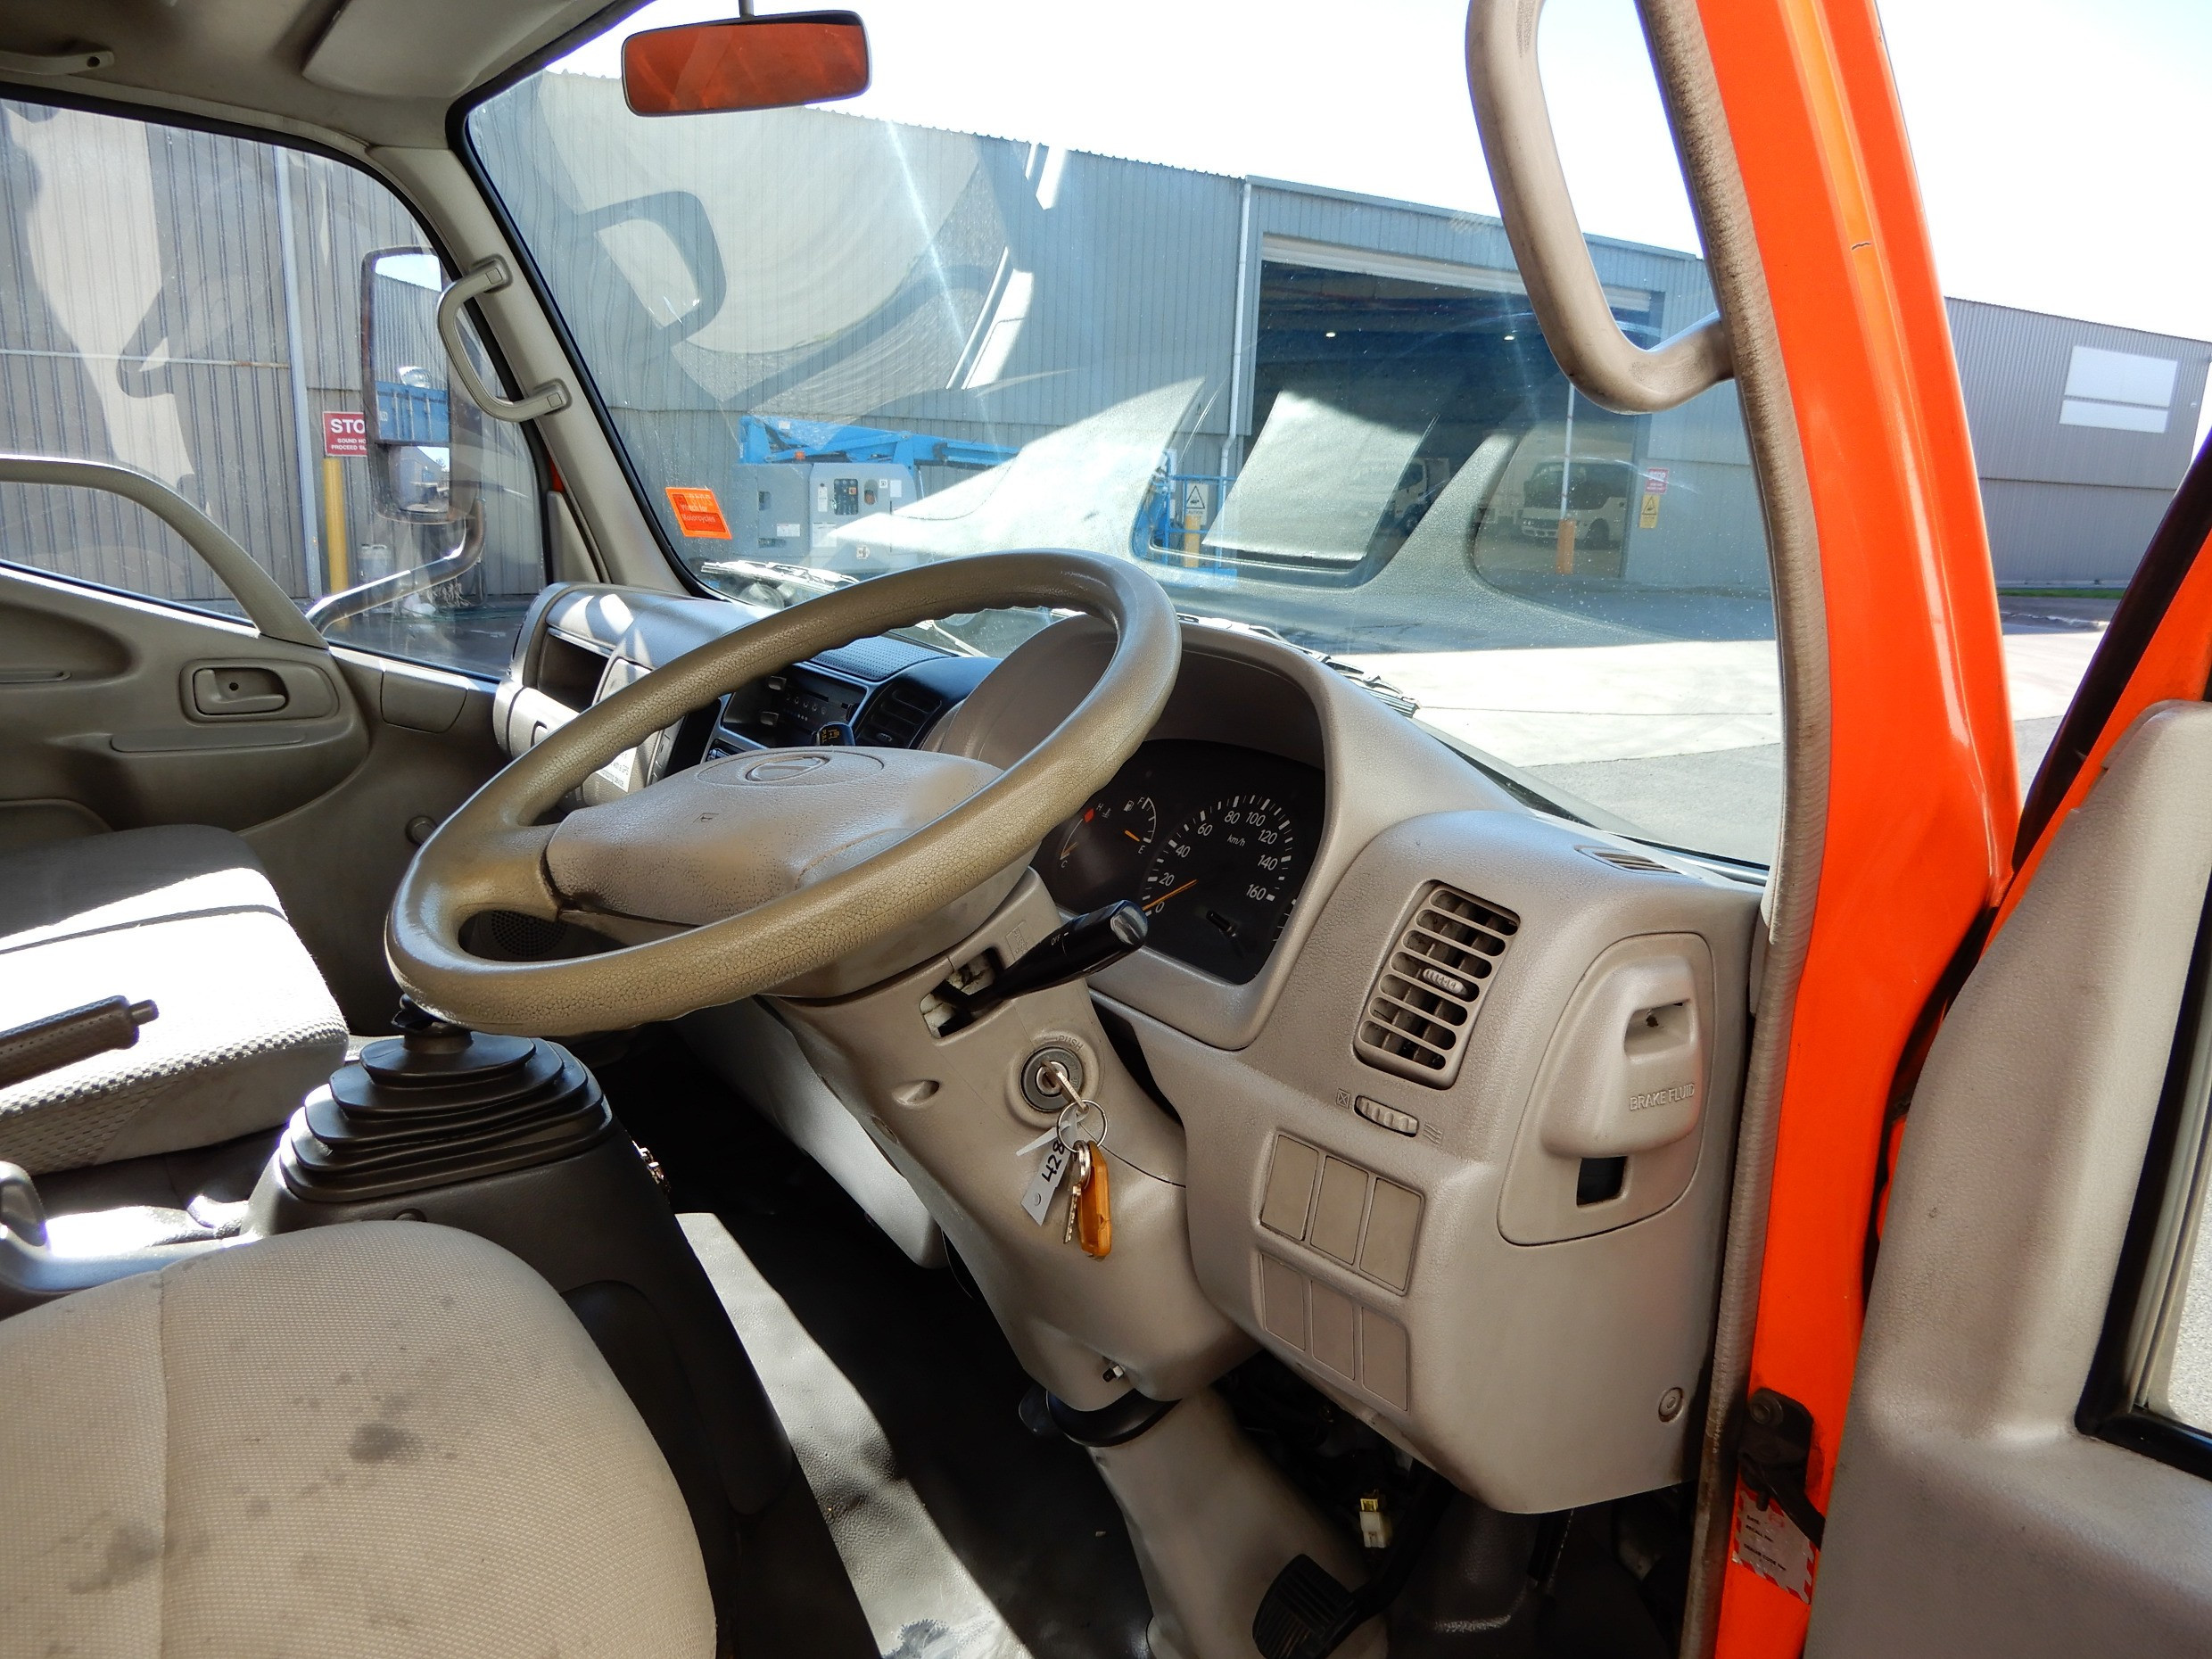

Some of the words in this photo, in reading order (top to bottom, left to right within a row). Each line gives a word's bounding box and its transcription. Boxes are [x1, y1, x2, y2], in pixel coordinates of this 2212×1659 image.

[330, 418, 366, 434] STO
[1095, 803, 1104, 811] H
[1136, 796, 1145, 805] F
[1224, 810, 1241, 824] 80
[1245, 811, 1267, 827] 100
[1197, 822, 1213, 837] 60
[1258, 829, 1278, 845] 120
[1226, 833, 1246, 846] km/h
[1137, 845, 1146, 854] E
[1175, 844, 1191, 858] 40
[1061, 860, 1069, 869] C
[1257, 854, 1278, 871] 140
[1159, 871, 1175, 887] 20
[1246, 883, 1267, 901] 160
[1155, 901, 1165, 913] 0
[1051, 933, 1061, 946] OFF
[1059, 1035, 1085, 1052] PUSH
[1629, 1089, 1667, 1111] BRAKE
[1668, 1082, 1696, 1103] FLUID
[1041, 1139, 1065, 1183] 428
